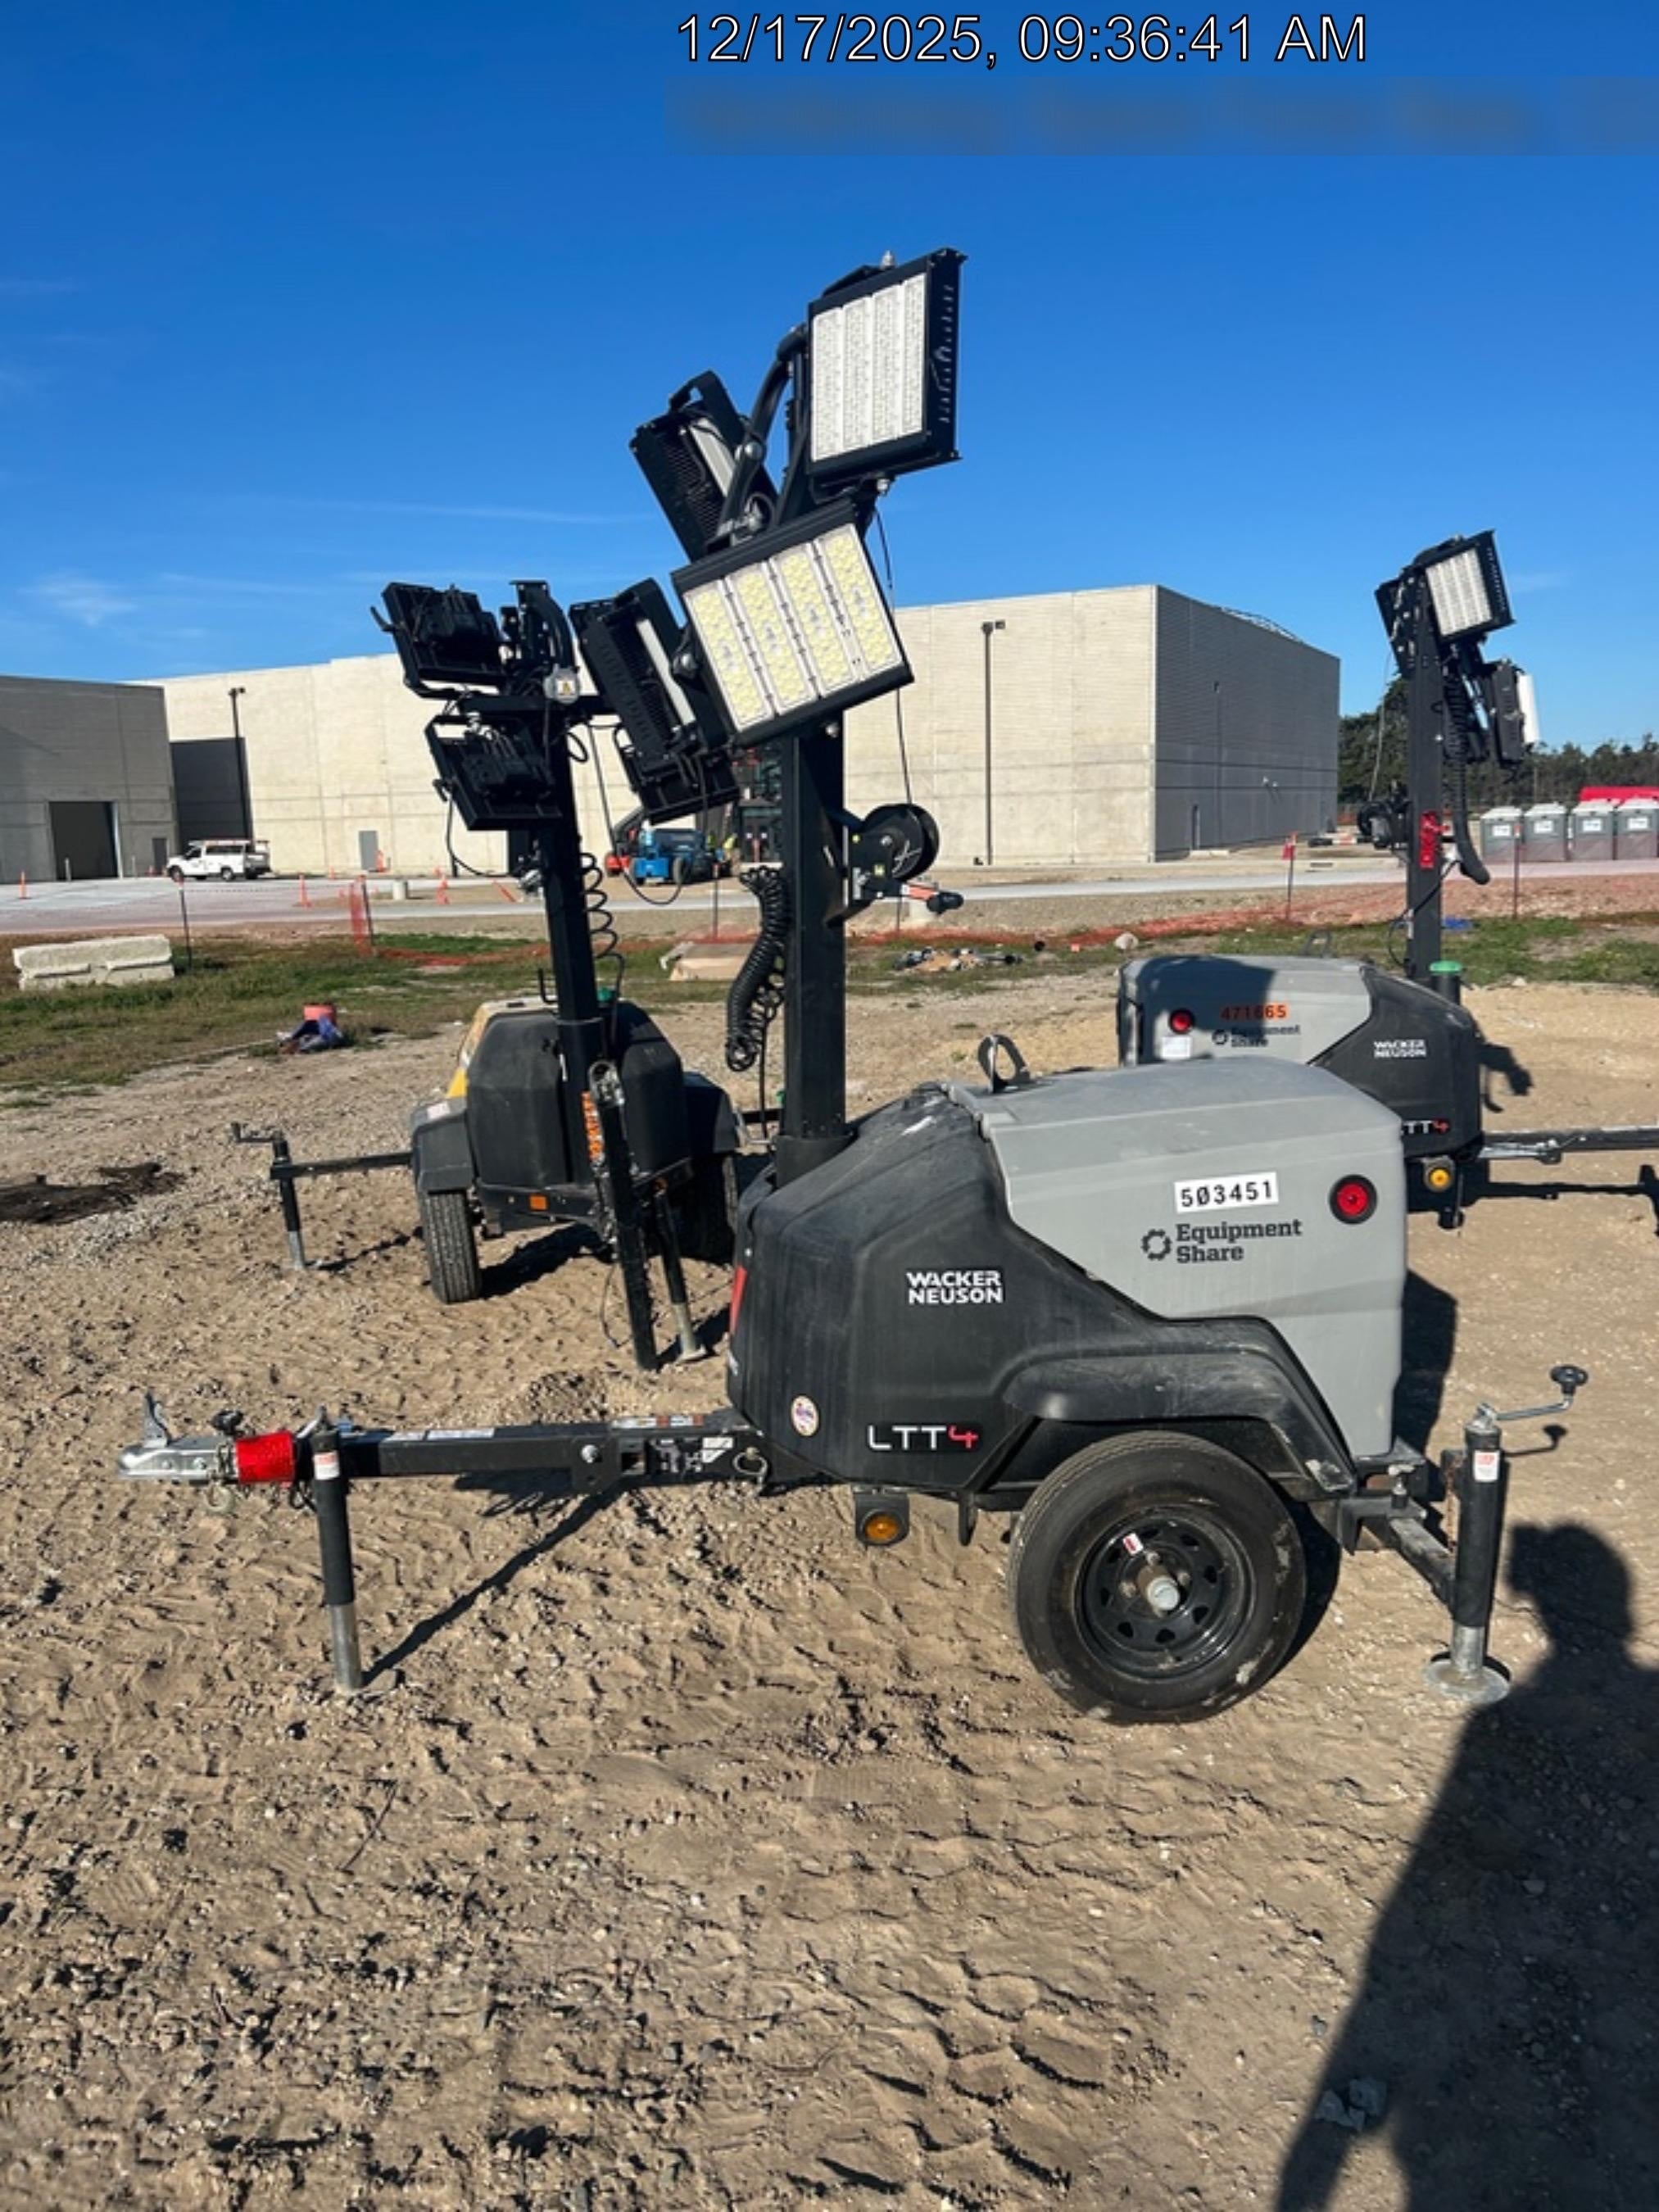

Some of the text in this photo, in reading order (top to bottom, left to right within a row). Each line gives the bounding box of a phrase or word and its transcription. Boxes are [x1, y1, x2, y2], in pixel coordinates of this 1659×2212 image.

[1220, 1004, 1287, 1021] 471665
[1400, 1119, 1450, 1135] TT4
[1180, 1180, 1272, 1208] 503451
[1176, 1218, 1303, 1244] Equipment
[1176, 1245, 1244, 1263] Share
[905, 1270, 1002, 1288] WACKER
[909, 1287, 1003, 1305] NEUSON
[867, 1424, 979, 1451] LTT4
